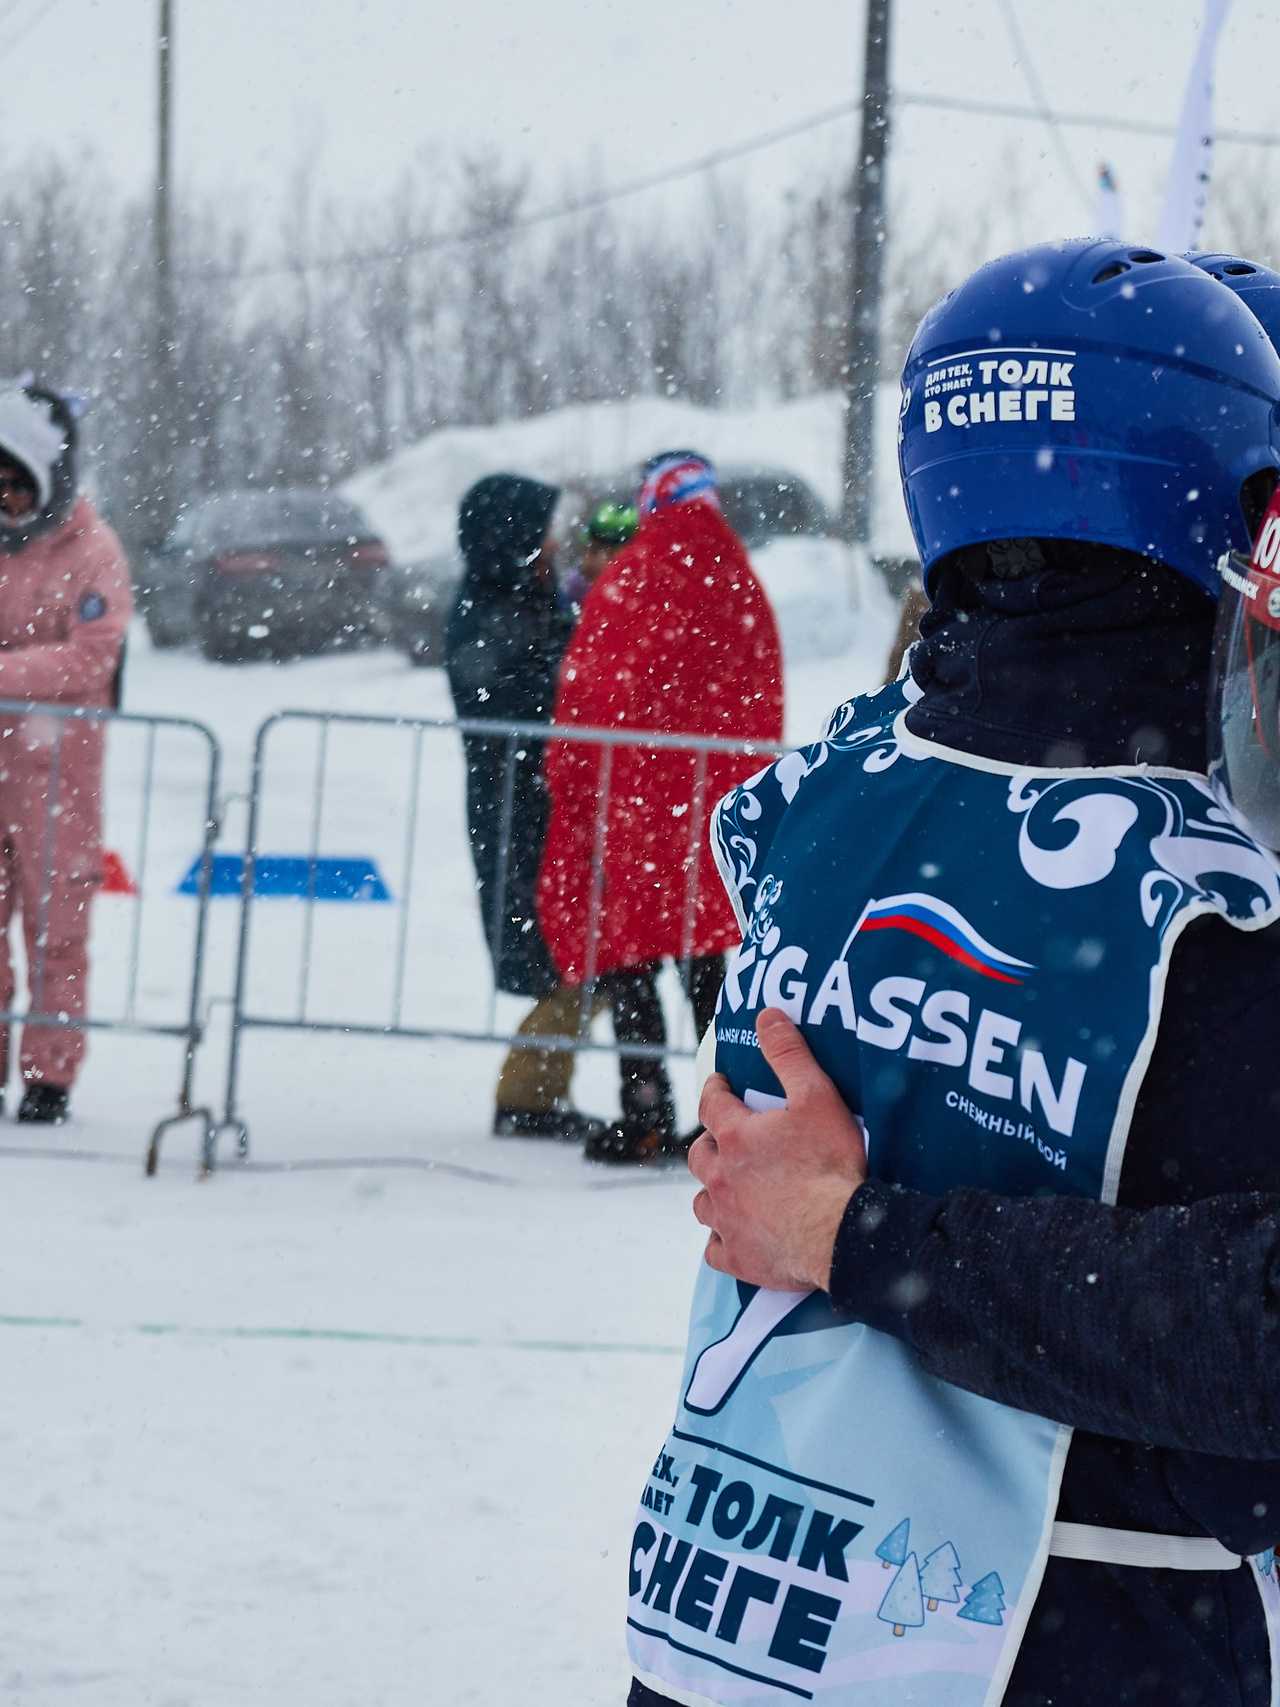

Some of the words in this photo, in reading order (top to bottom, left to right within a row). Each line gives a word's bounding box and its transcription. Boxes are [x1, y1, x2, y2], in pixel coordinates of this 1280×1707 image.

[925, 369, 947, 388] ДЛЯ
[947, 363, 974, 380] ТЕХ,
[978, 359, 1075, 387] ТОЛК
[924, 384, 941, 399] КТО
[941, 376, 973, 394] ЗНАЕТ
[924, 401, 943, 434] В
[947, 390, 1076, 427] СНЕГЕ
[717, 1026, 741, 1044] ANSK
[945, 1090, 1035, 1144] СНЕЖНЫЙ
[1037, 1136, 1068, 1171] БОЙ
[685, 1463, 865, 1583] ТОЛК
